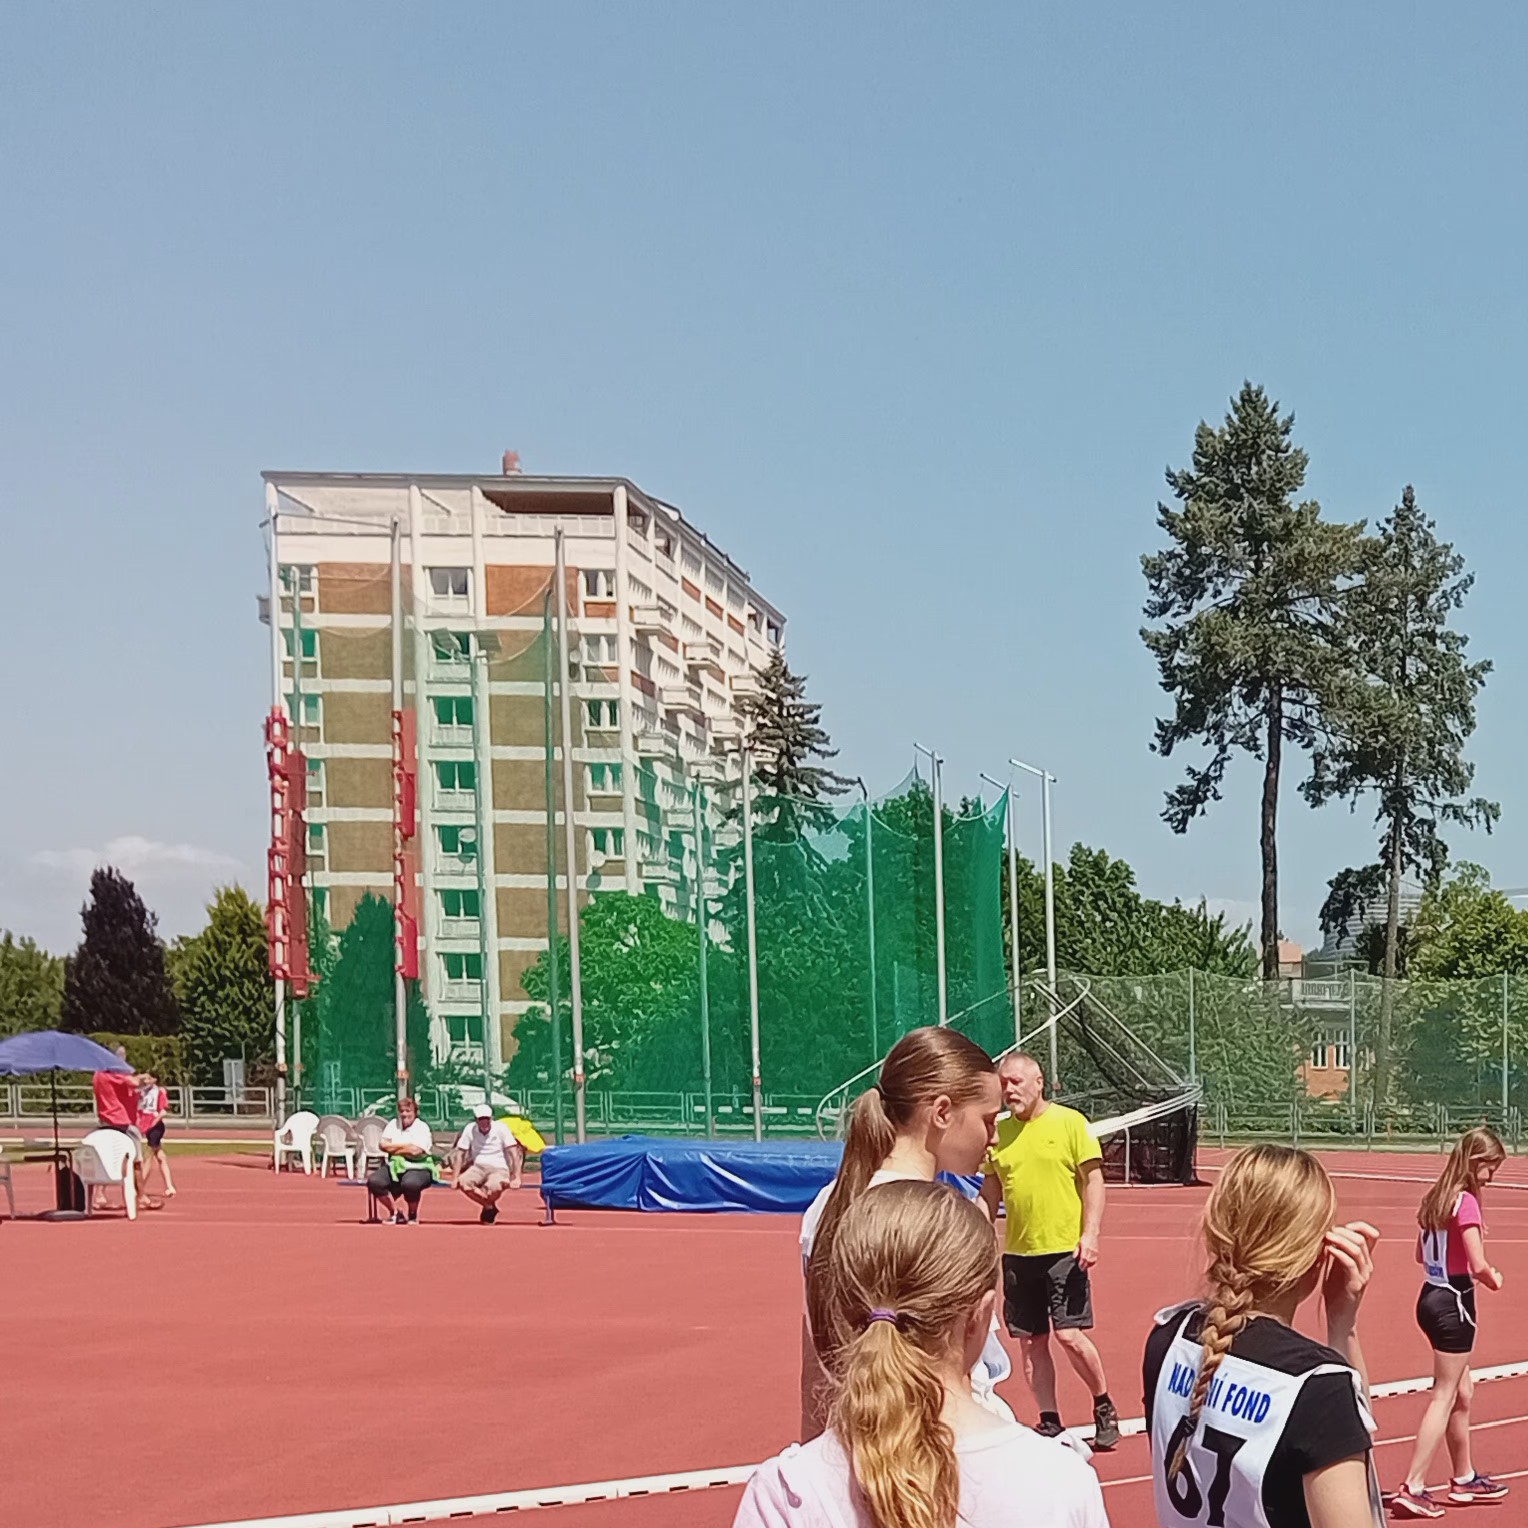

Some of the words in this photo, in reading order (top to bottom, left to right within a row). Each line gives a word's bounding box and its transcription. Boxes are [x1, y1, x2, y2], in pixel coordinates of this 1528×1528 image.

[1167, 1362, 1228, 1409] NADNÍ
[1221, 1383, 1271, 1423] FOND
[1164, 1415, 1247, 1528] 67
